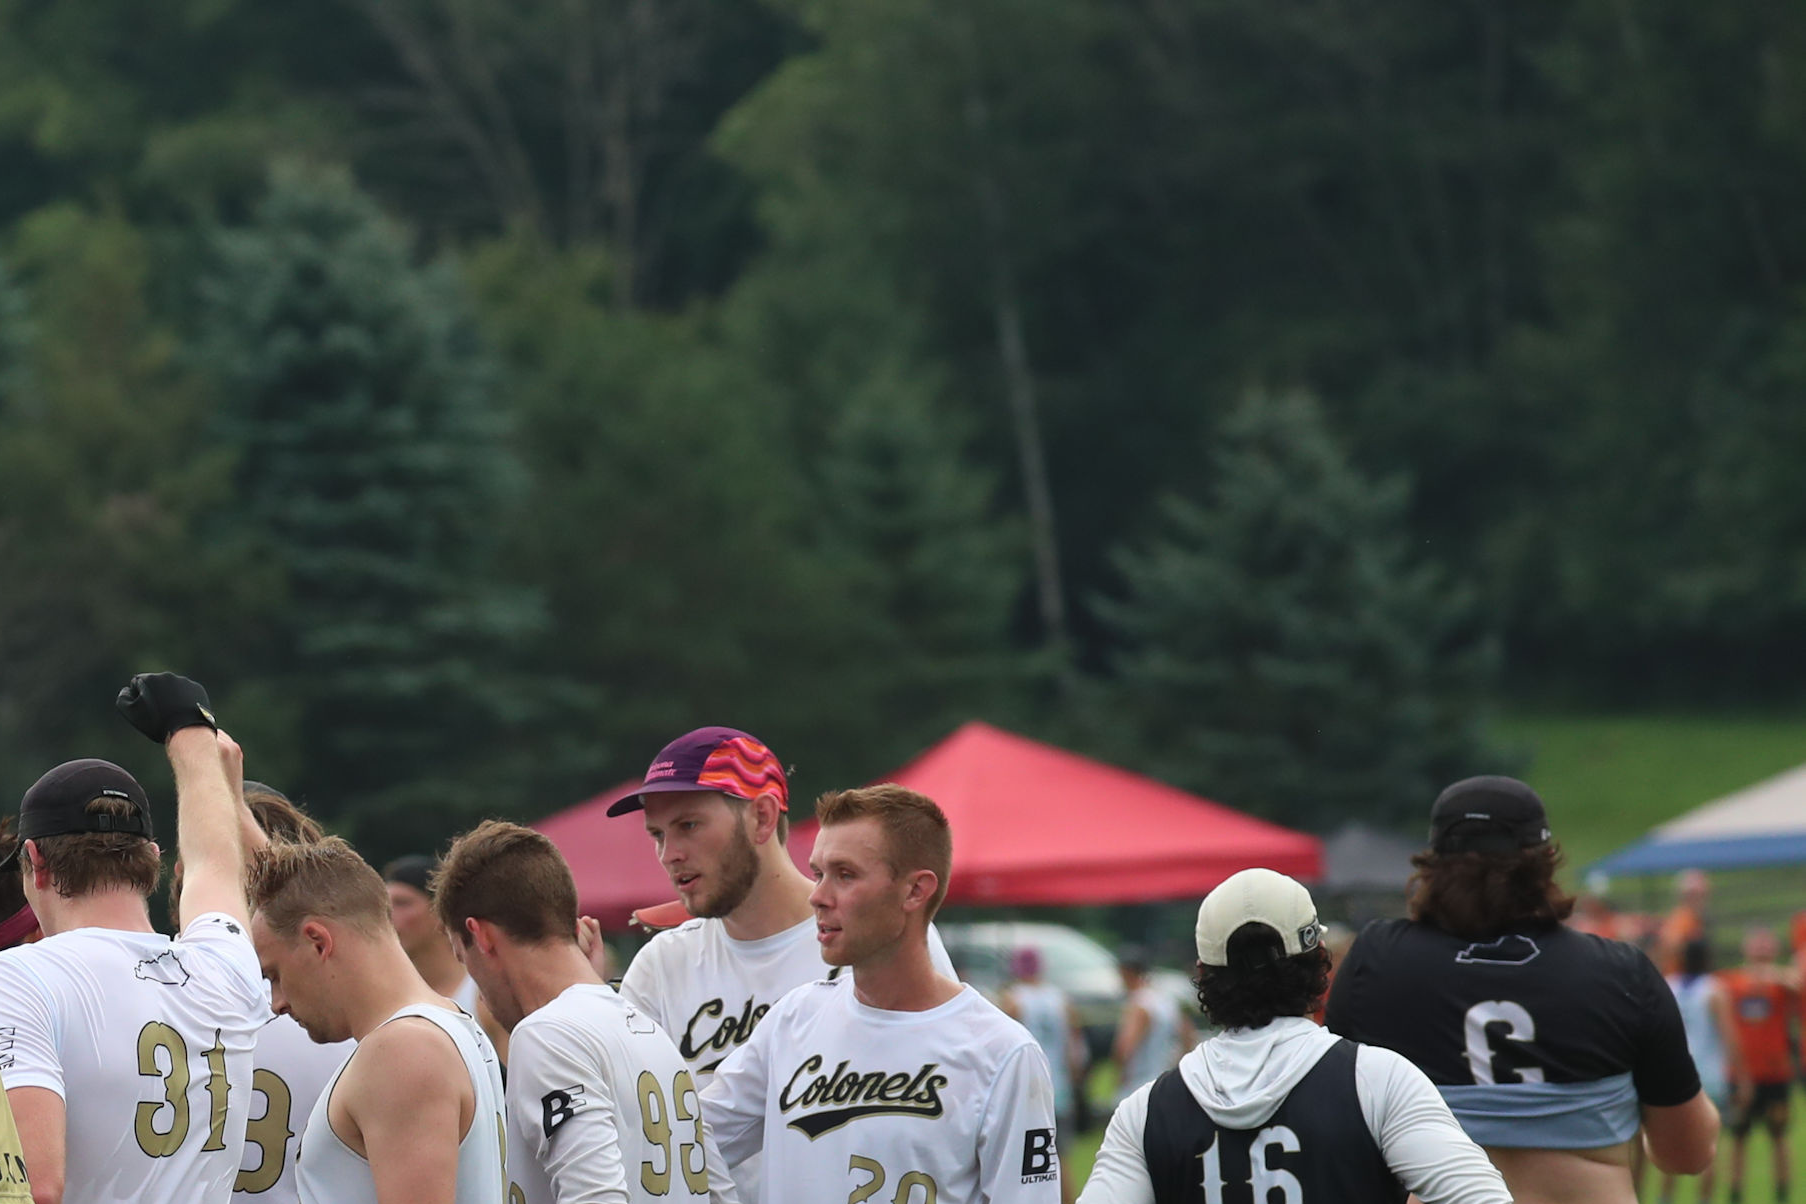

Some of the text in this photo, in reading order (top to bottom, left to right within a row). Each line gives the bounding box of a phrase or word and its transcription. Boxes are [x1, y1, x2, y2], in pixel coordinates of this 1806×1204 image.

[680, 994, 771, 1062] Colo
[134, 1020, 232, 1158] 31
[779, 1054, 949, 1120] Colonels
[636, 1069, 711, 1197] 93
[1021, 1173, 1057, 1185] ULTIMAT
